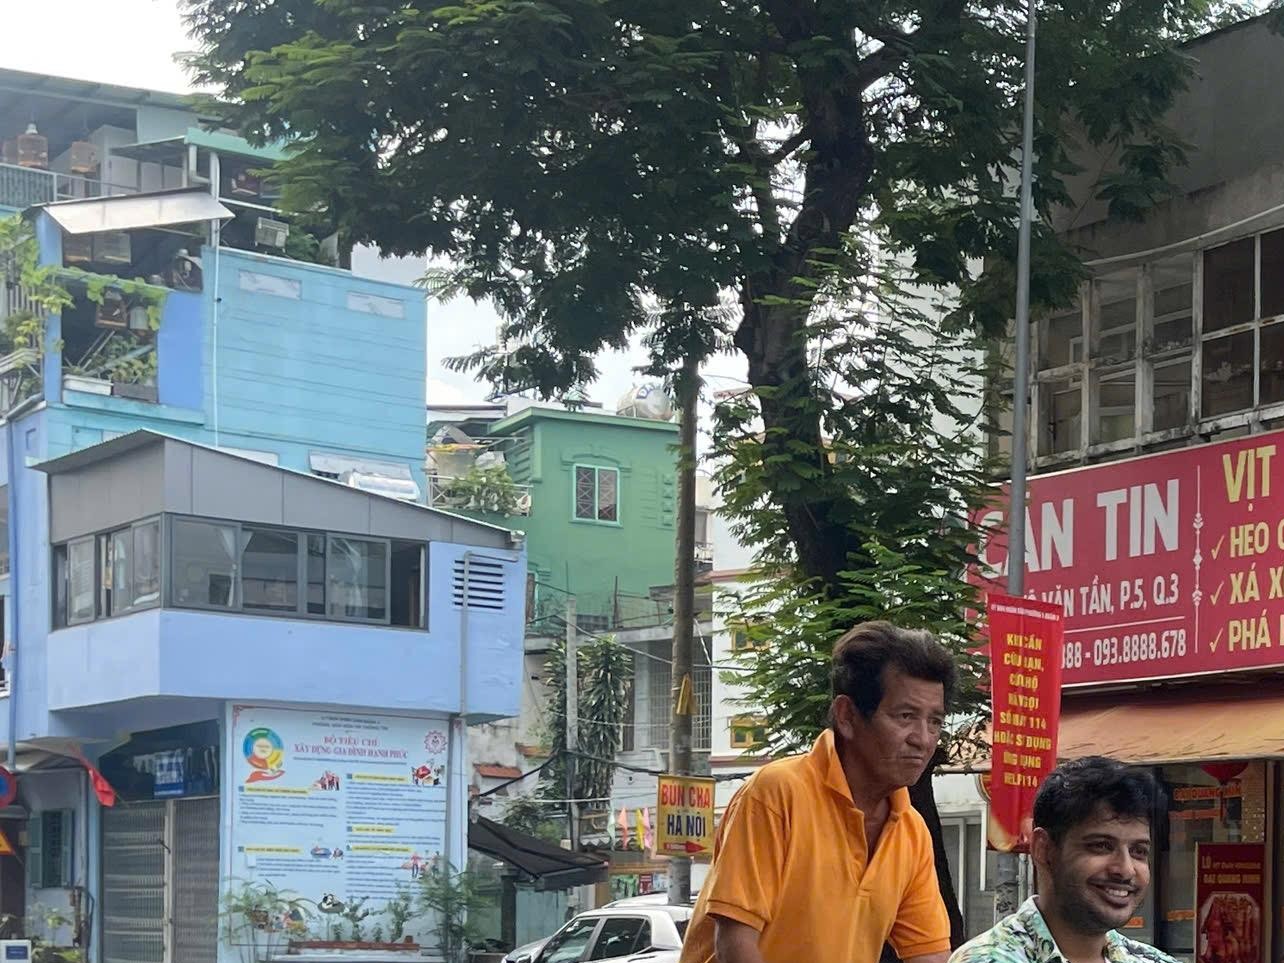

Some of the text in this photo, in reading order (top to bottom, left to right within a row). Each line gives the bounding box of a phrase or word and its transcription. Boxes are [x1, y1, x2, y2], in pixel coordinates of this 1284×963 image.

[1222, 446, 1277, 512] VỊT
[1096, 479, 1180, 561] TIN
[1229, 521, 1270, 558] HEO
[1120, 578, 1147, 611] P.5,
[1153, 573, 1179, 606] Q.3
[1229, 562, 1260, 604] XÁ
[1094, 629, 1187, 666] 093.8888.678
[1228, 608, 1272, 651] PHÁ
